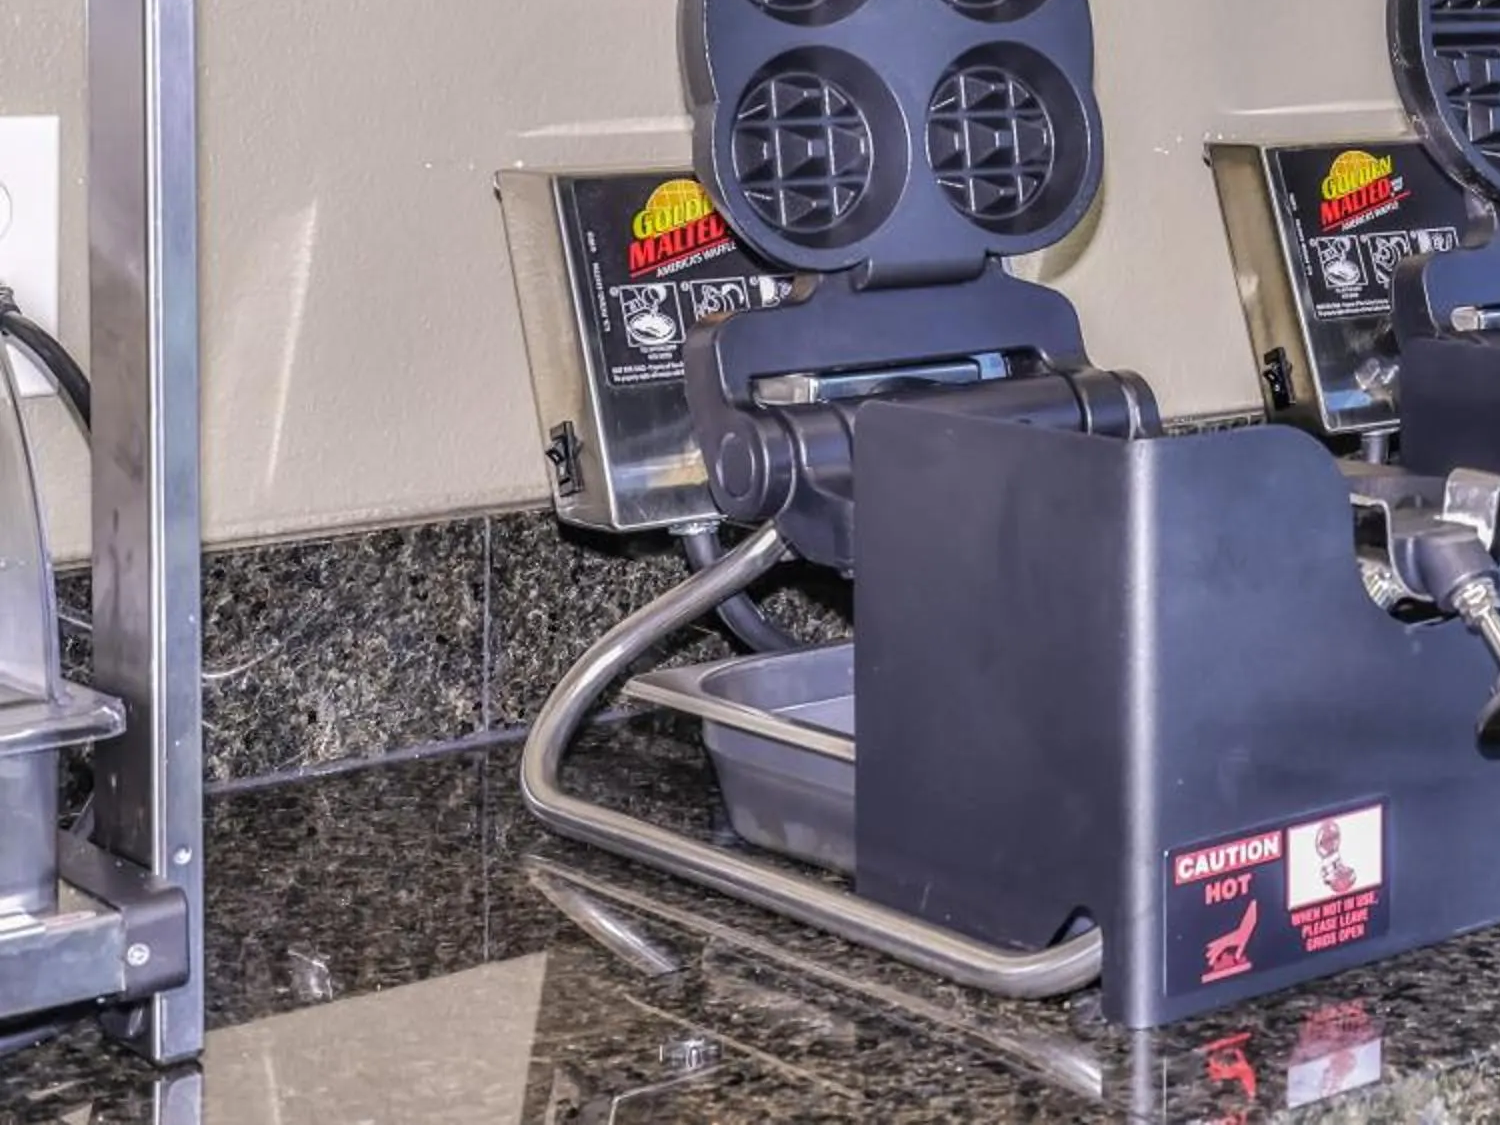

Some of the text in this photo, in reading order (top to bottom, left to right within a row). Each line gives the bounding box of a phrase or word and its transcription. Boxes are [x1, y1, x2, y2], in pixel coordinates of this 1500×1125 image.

[1322, 154, 1392, 200] GOLDEN
[632, 198, 714, 239] GOLD
[1321, 178, 1391, 226] MALTED
[629, 214, 726, 271] MALTED
[1178, 835, 1280, 880] CAUTION
[1205, 873, 1251, 905] HOT
[1291, 906, 1321, 926] WHEN
[1322, 900, 1342, 917] NOT
[1301, 916, 1337, 939] PLEASE
[1338, 923, 1364, 942] OPEN
